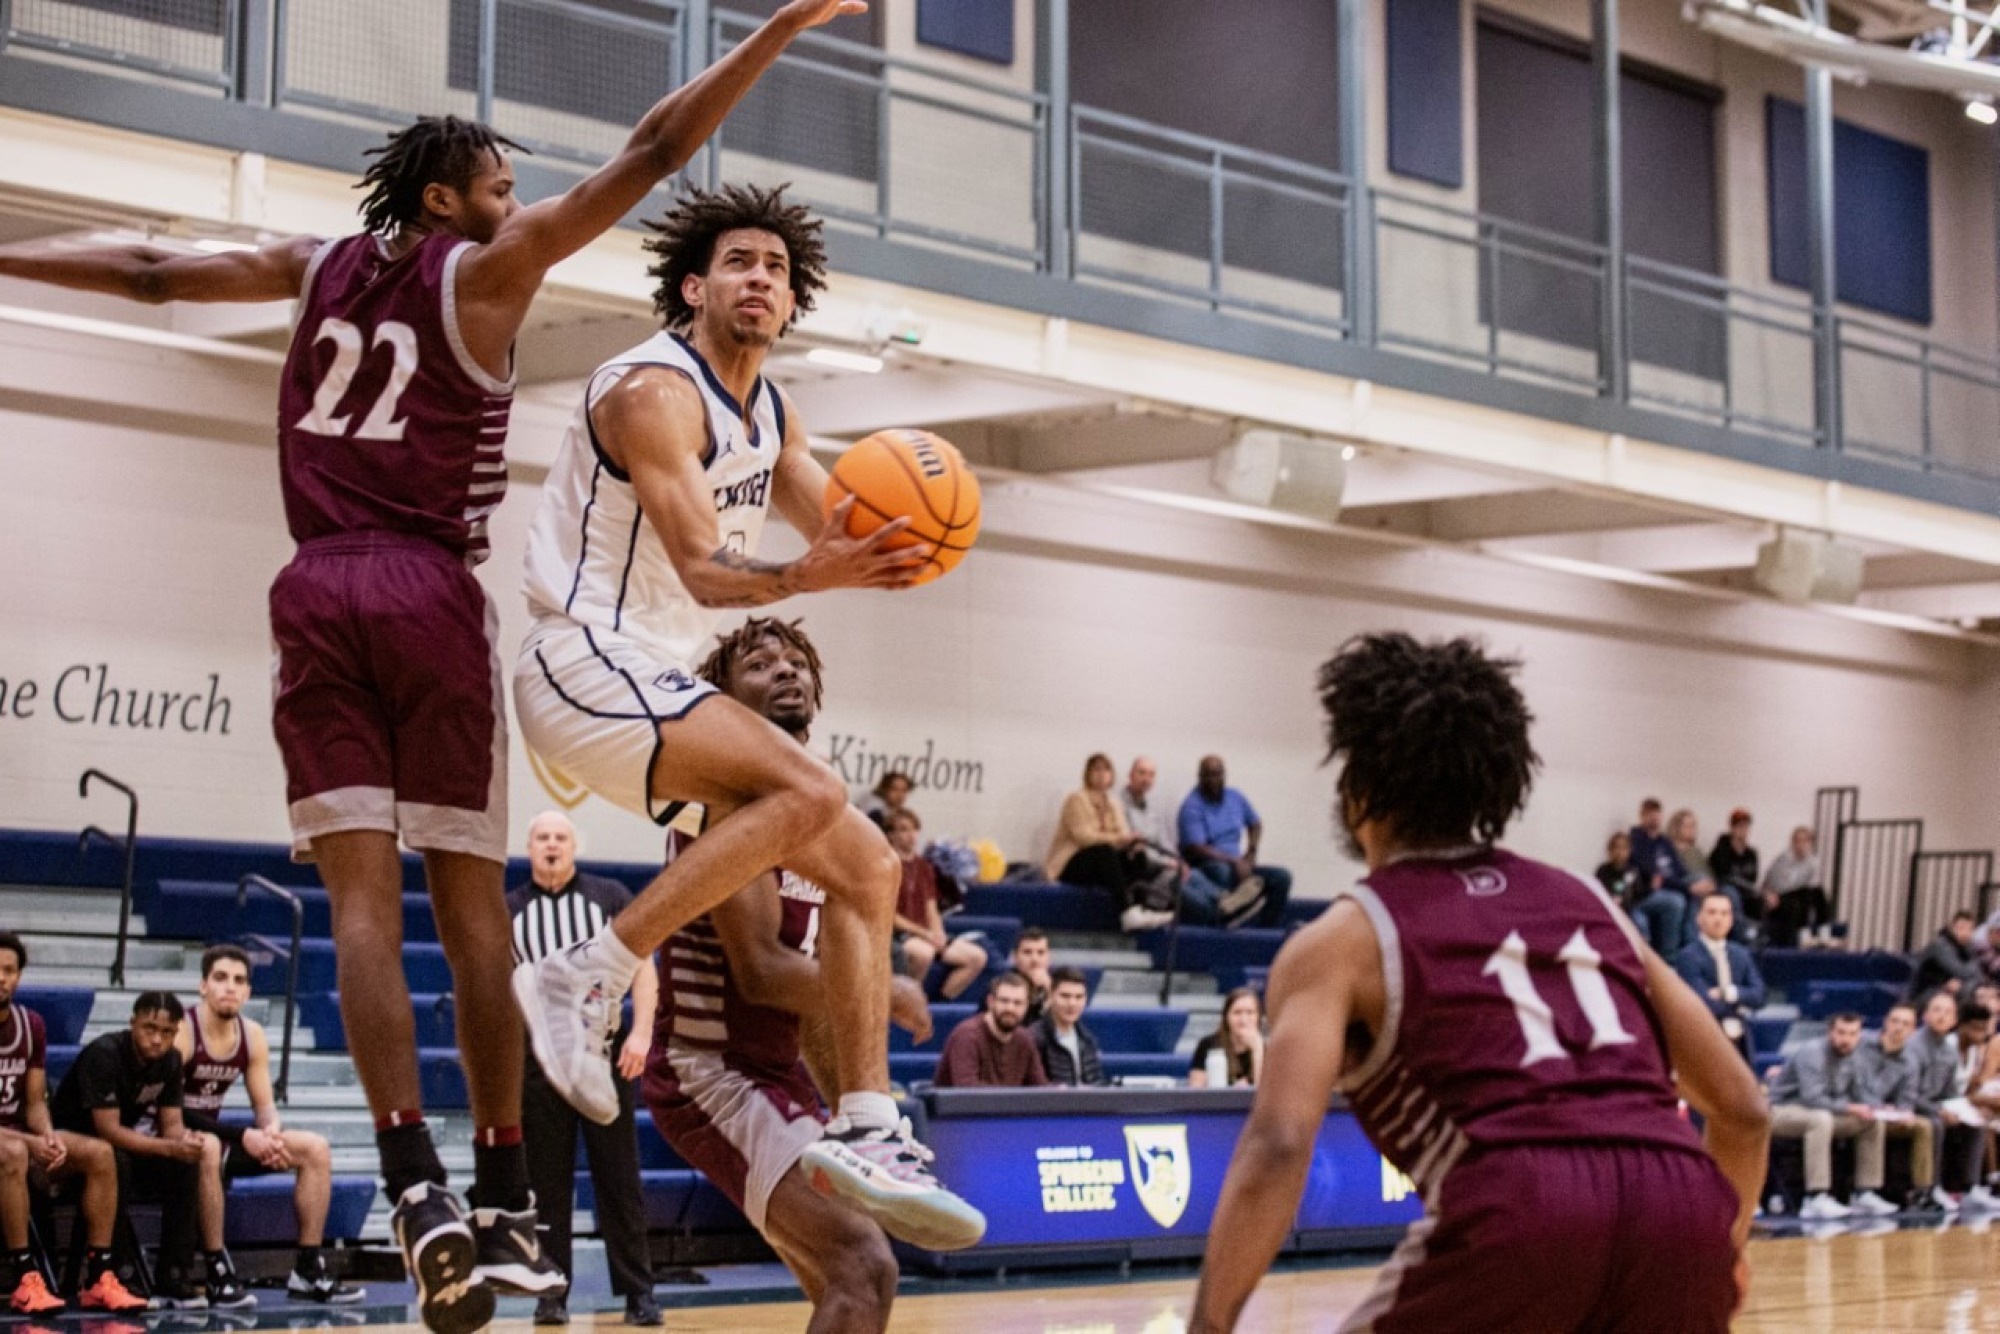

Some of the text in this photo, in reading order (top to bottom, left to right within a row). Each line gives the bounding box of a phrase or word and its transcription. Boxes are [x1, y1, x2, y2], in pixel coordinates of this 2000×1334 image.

[294, 317, 418, 441] 22
[53, 662, 232, 736] Church
[1481, 923, 1638, 1068] 11
